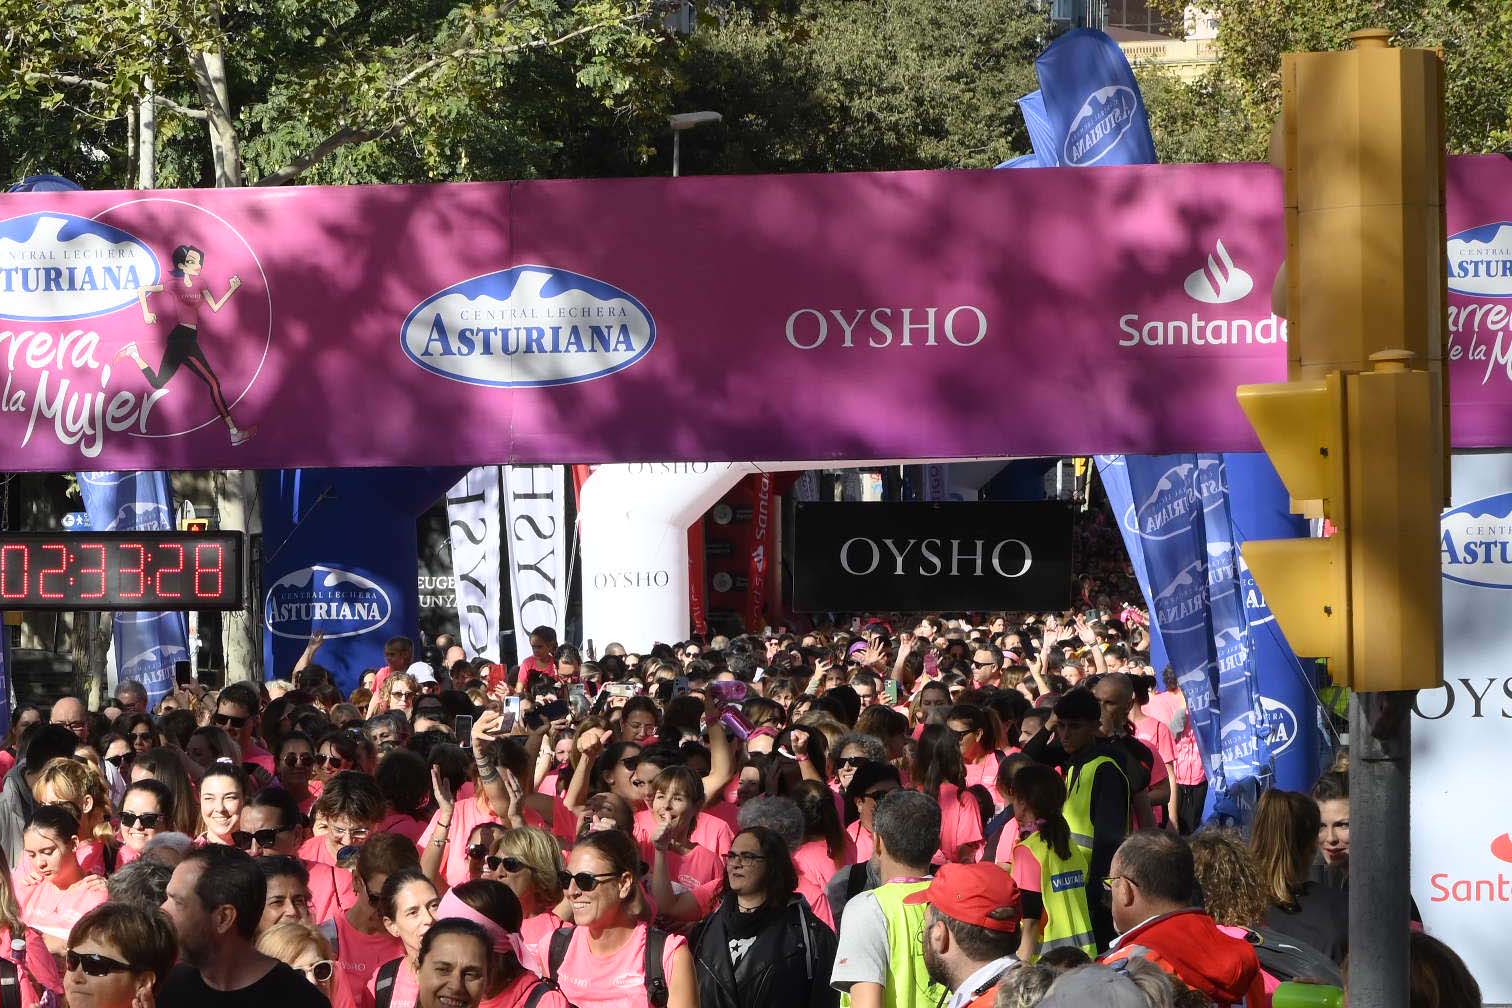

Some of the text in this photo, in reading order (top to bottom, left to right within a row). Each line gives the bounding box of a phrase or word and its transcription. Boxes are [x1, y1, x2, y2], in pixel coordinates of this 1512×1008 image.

[63, 249, 136, 259] LECHERA
[460, 306, 629, 321] CENTRAL LECHERA
[785, 305, 988, 349] OYSHO
[421, 313, 636, 357] ASTURIANA
[1468, 333, 1487, 361] la
[1, 372, 26, 412] la
[21, 365, 170, 458] Mujer
[1, 543, 223, 598] 02:33:28
[840, 537, 1033, 577] OYSHO
[594, 570, 669, 590] OYSHO
[270, 594, 382, 622] ASTURIANA
